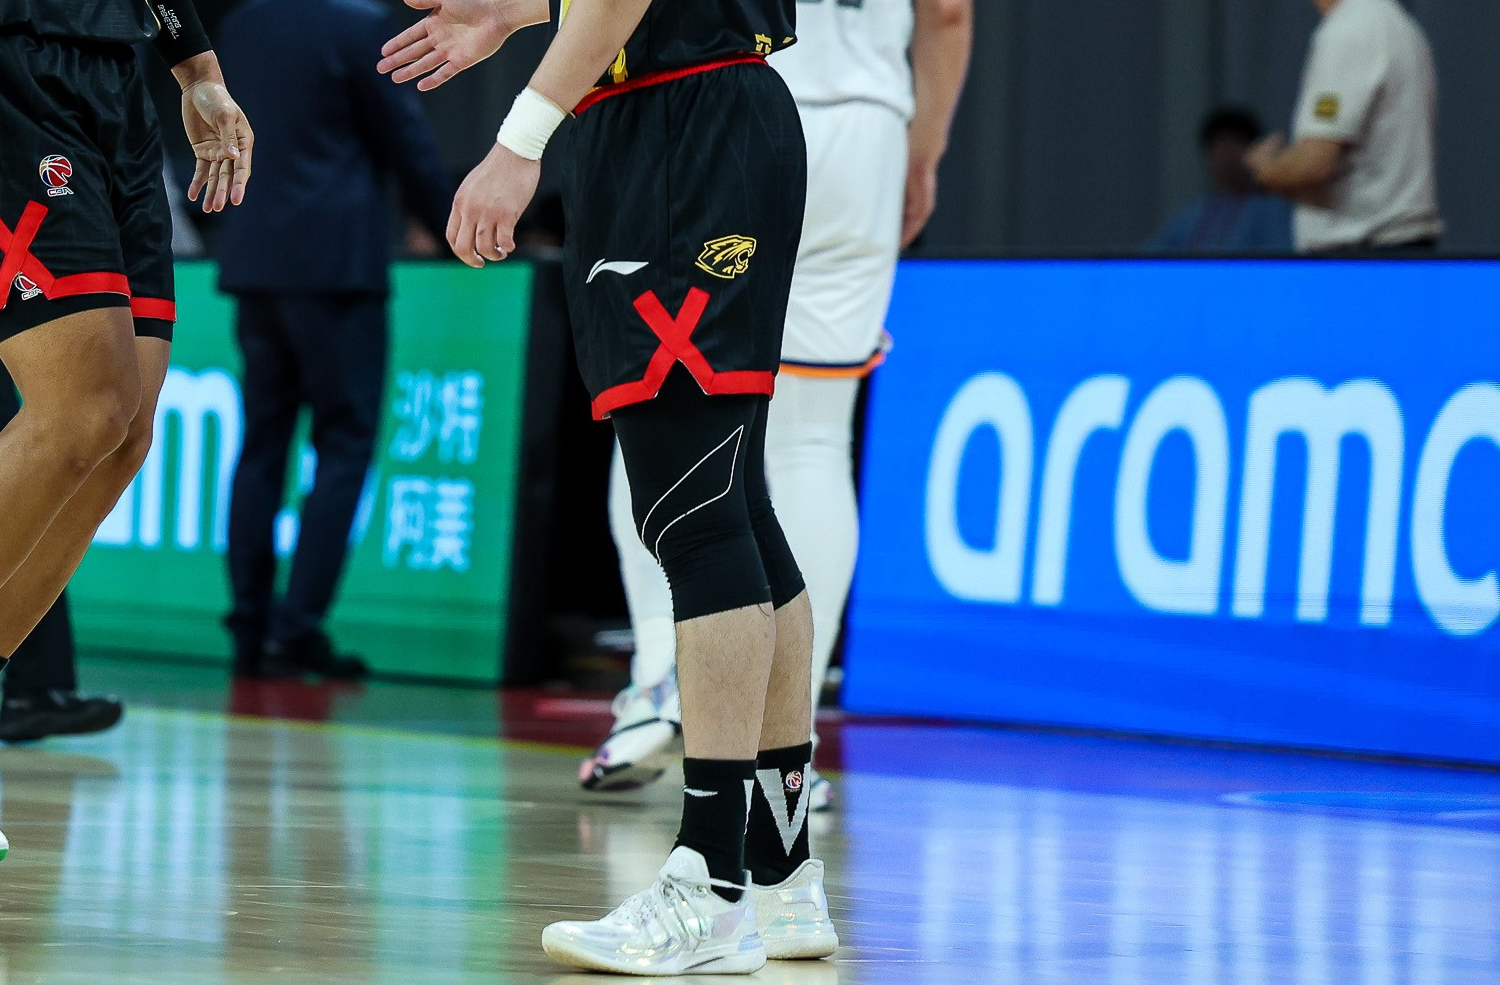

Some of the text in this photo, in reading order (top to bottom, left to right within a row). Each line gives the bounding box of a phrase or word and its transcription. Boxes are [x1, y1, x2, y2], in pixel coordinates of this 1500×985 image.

[47, 186, 74, 197] CBA
[389, 369, 483, 464] 沙特
[382, 475, 475, 572] 阿美
